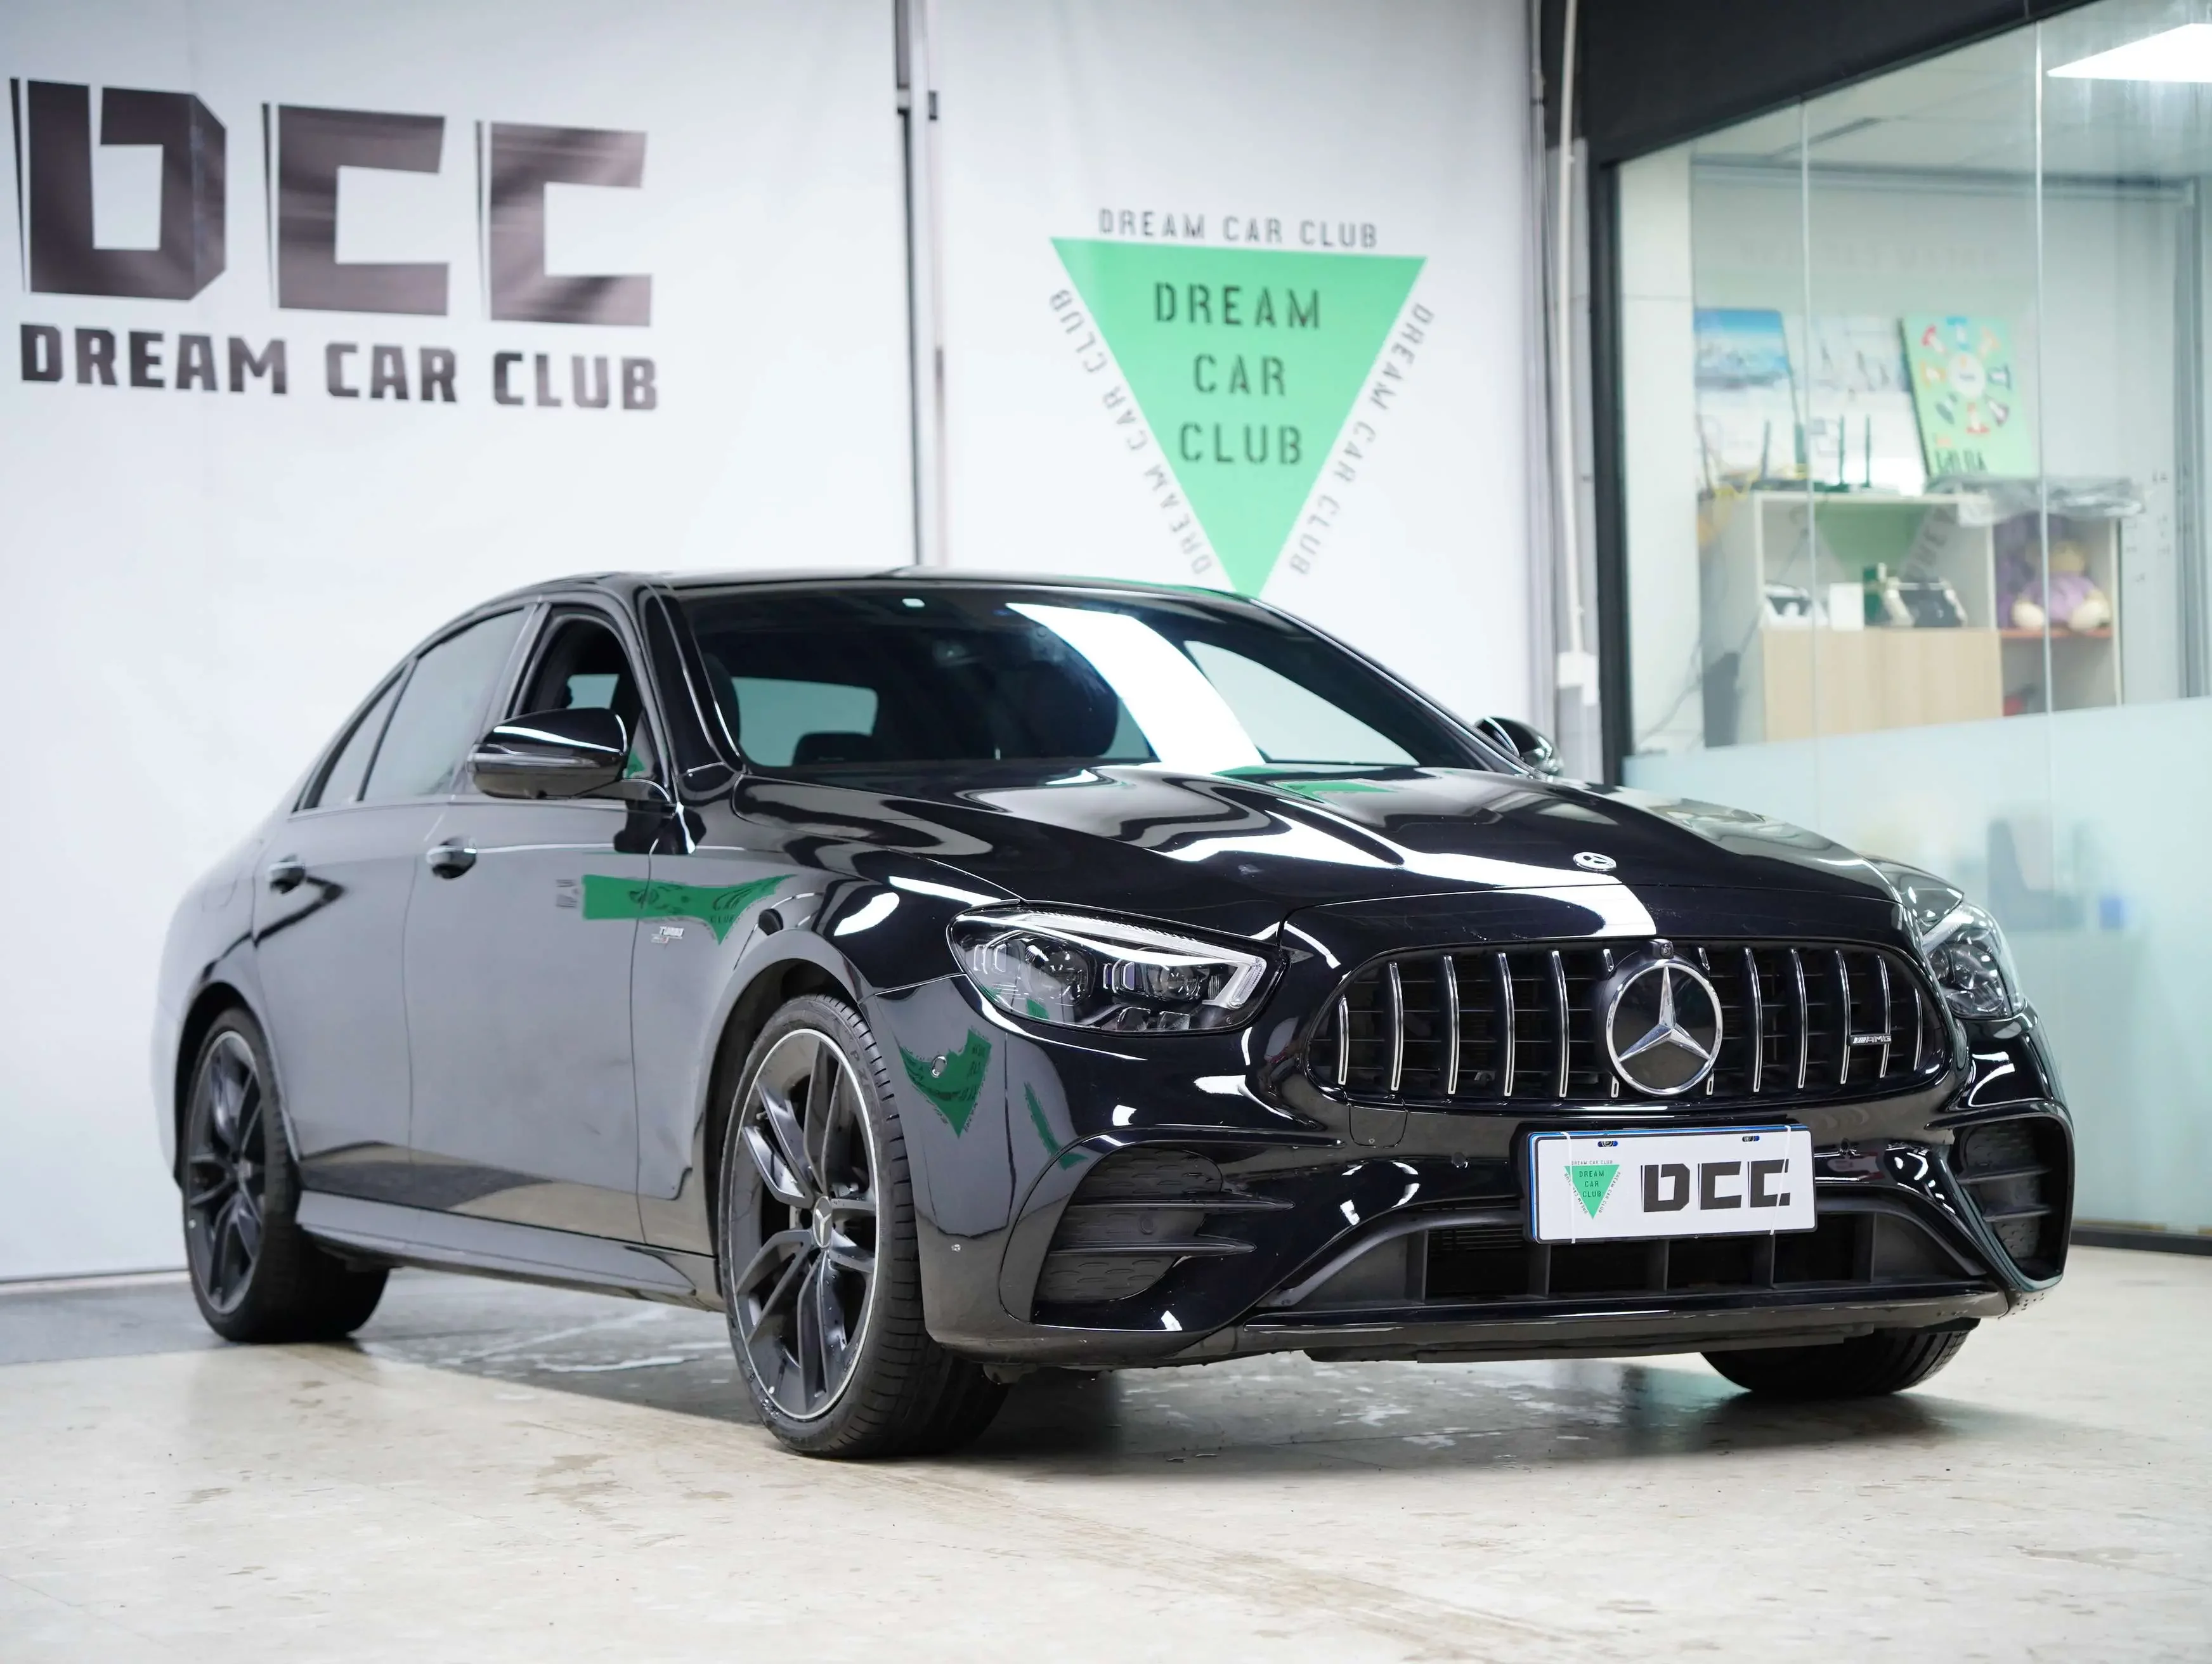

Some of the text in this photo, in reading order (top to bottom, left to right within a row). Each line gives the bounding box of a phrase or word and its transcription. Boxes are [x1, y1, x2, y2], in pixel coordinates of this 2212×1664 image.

[10, 77, 653, 327] DCC
[1099, 208, 1378, 249] DREAM CAR CLUB
[1154, 281, 1321, 330] DREAM
[20, 322, 660, 412] DREAM CAR CLUB
[1192, 353, 1287, 396] CAR
[1178, 421, 1304, 465] CLUB
[1289, 302, 1436, 576] DREAM CAR CLUB
[1864, 1035, 1892, 1043] AMG
[1640, 1159, 1791, 1214] DCC
